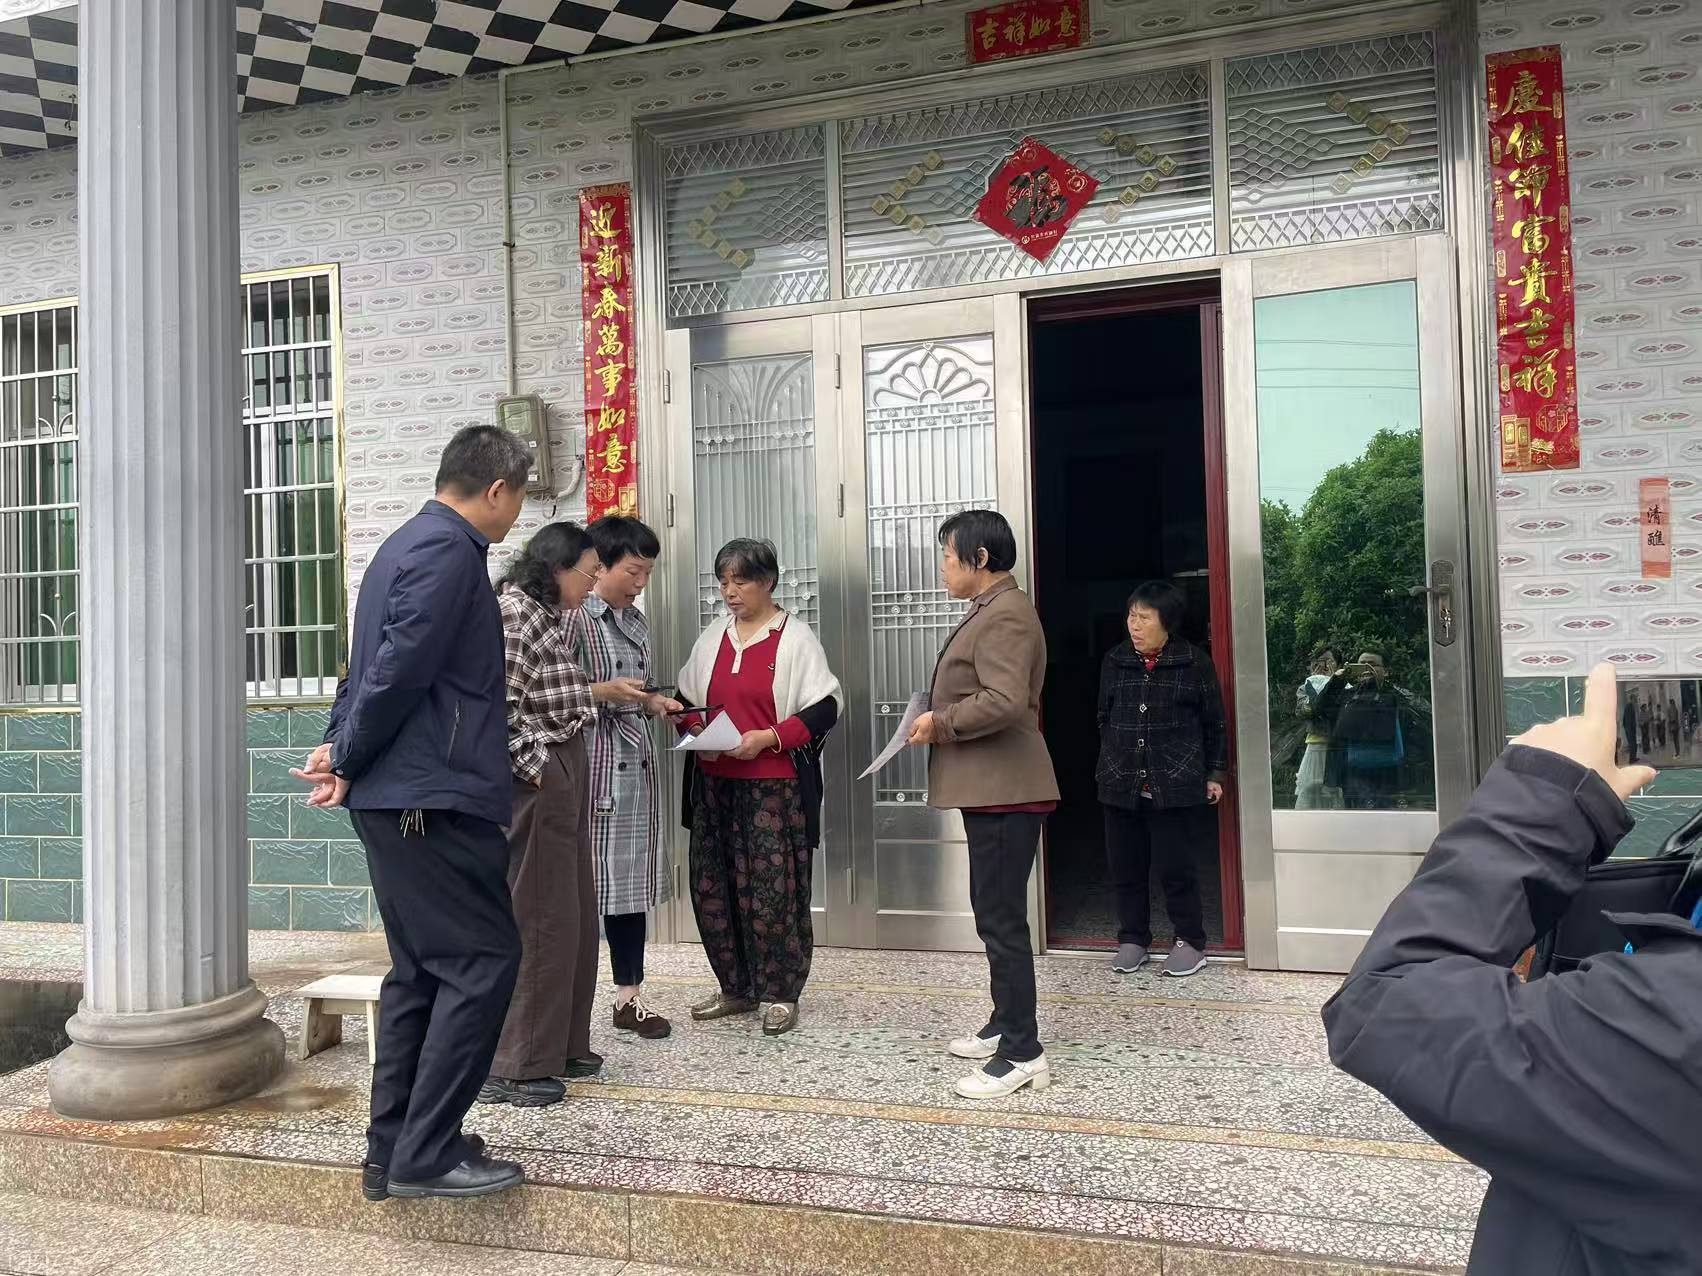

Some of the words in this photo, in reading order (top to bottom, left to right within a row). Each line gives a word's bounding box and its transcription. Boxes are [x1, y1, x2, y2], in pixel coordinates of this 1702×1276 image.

[976, 5, 1077, 50] 吉祥如意
[1004, 165, 1067, 229] 福
